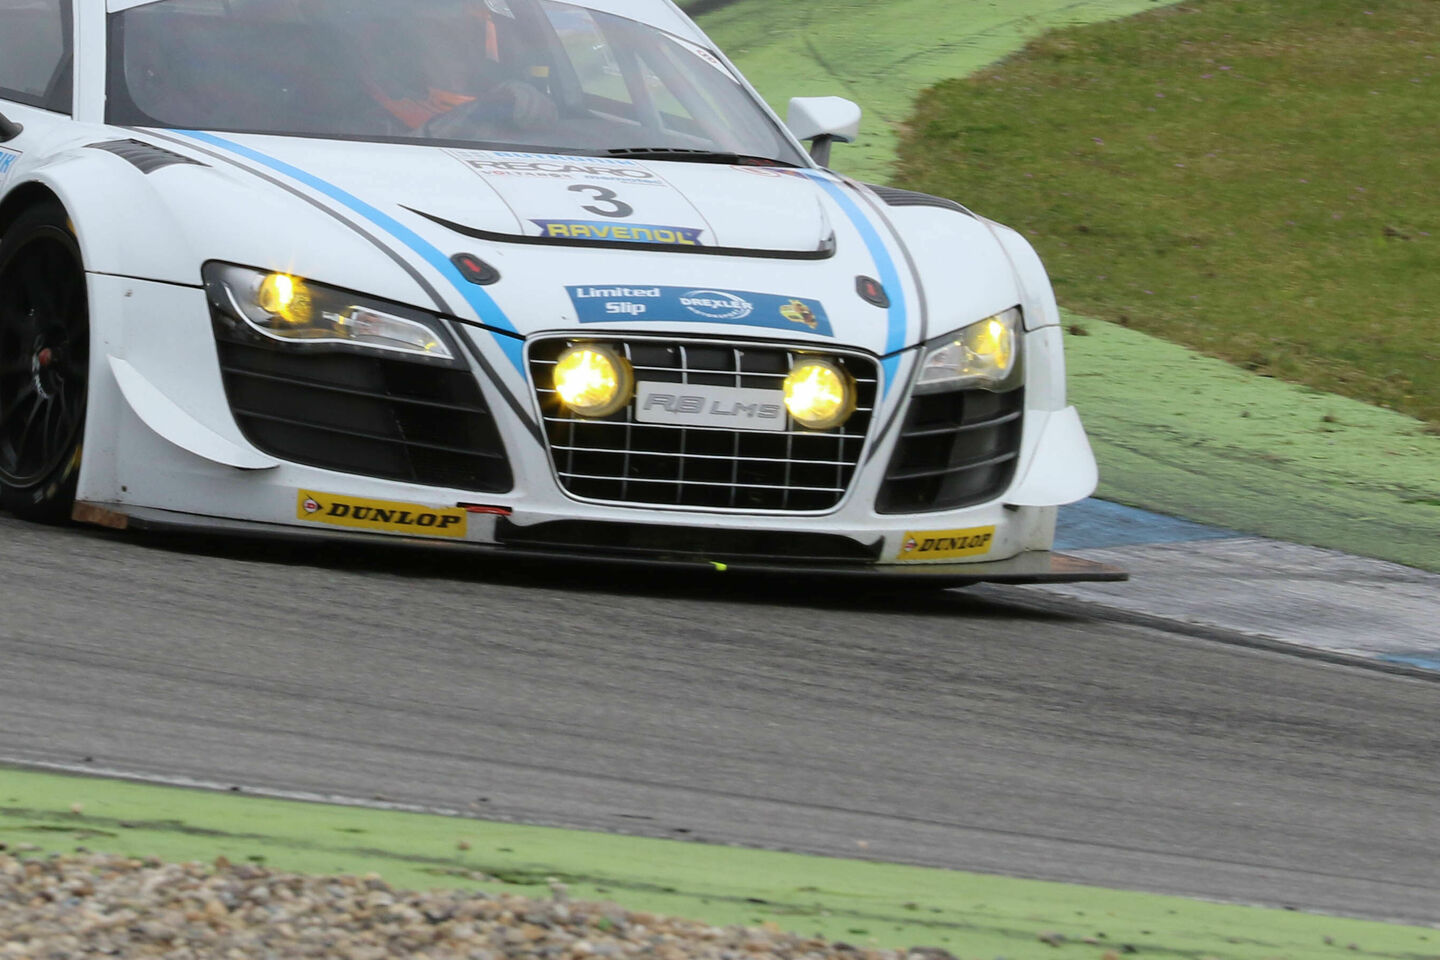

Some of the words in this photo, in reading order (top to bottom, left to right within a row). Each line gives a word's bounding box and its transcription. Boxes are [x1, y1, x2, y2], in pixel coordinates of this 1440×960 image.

[465, 159, 654, 179] RECARO
[567, 184, 634, 218] 3
[546, 223, 696, 245] RAVENOL
[576, 287, 660, 298] Limited
[605, 301, 647, 316] Slip
[679, 296, 754, 312] DREXLER
[642, 393, 706, 414] R8
[708, 400, 782, 419] LMS
[326, 502, 461, 529] DUNLOP
[917, 532, 992, 552] DUNLOP
